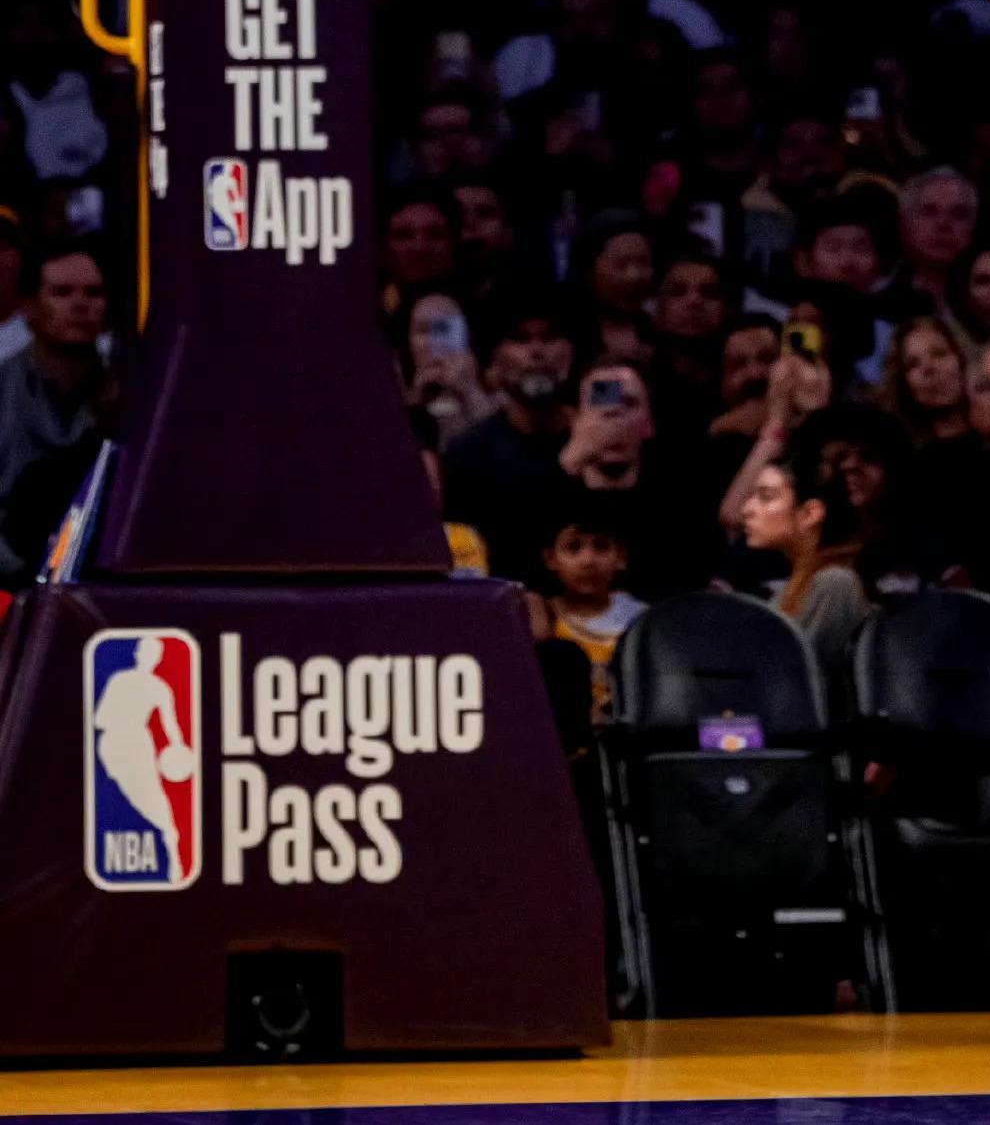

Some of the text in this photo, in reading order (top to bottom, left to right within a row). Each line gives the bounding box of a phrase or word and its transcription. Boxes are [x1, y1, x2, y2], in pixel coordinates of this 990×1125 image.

[224, 66, 329, 151] THE
[252, 158, 353, 265] App
[220, 631, 484, 777] League
[104, 831, 158, 874] NBA
[221, 760, 403, 885] Pass
